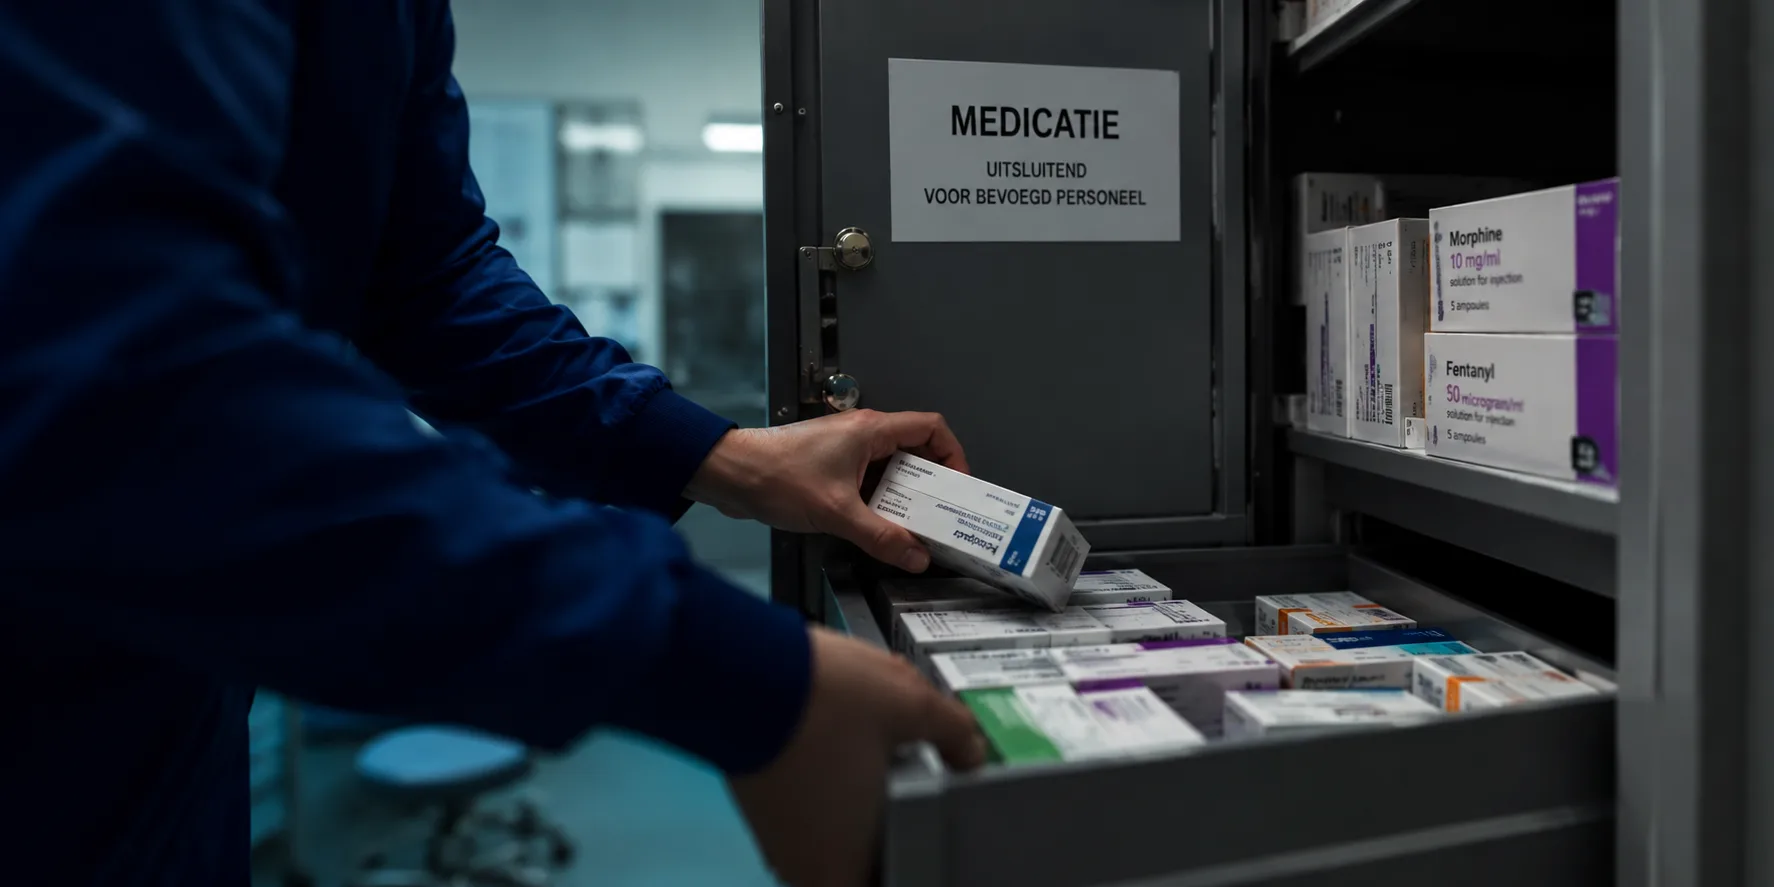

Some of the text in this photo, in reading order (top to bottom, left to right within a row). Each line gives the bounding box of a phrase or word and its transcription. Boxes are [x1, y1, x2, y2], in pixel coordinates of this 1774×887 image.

[951, 105, 1120, 140] MEDICATIE
[986, 161, 1087, 178] UITSLUITEND
[924, 188, 1146, 206] VOOR BEVOEGD PERSONEEL
[1450, 226, 1503, 248] Morphine
[1450, 248, 1501, 271] 10 mg/ml
[1450, 276, 1476, 287] solution
[1477, 275, 1488, 286] for
[1451, 301, 1455, 311] 5
[1446, 360, 1495, 383] Fentanyl
[1446, 384, 1460, 402] 50
[1447, 429, 1452, 439] 5
